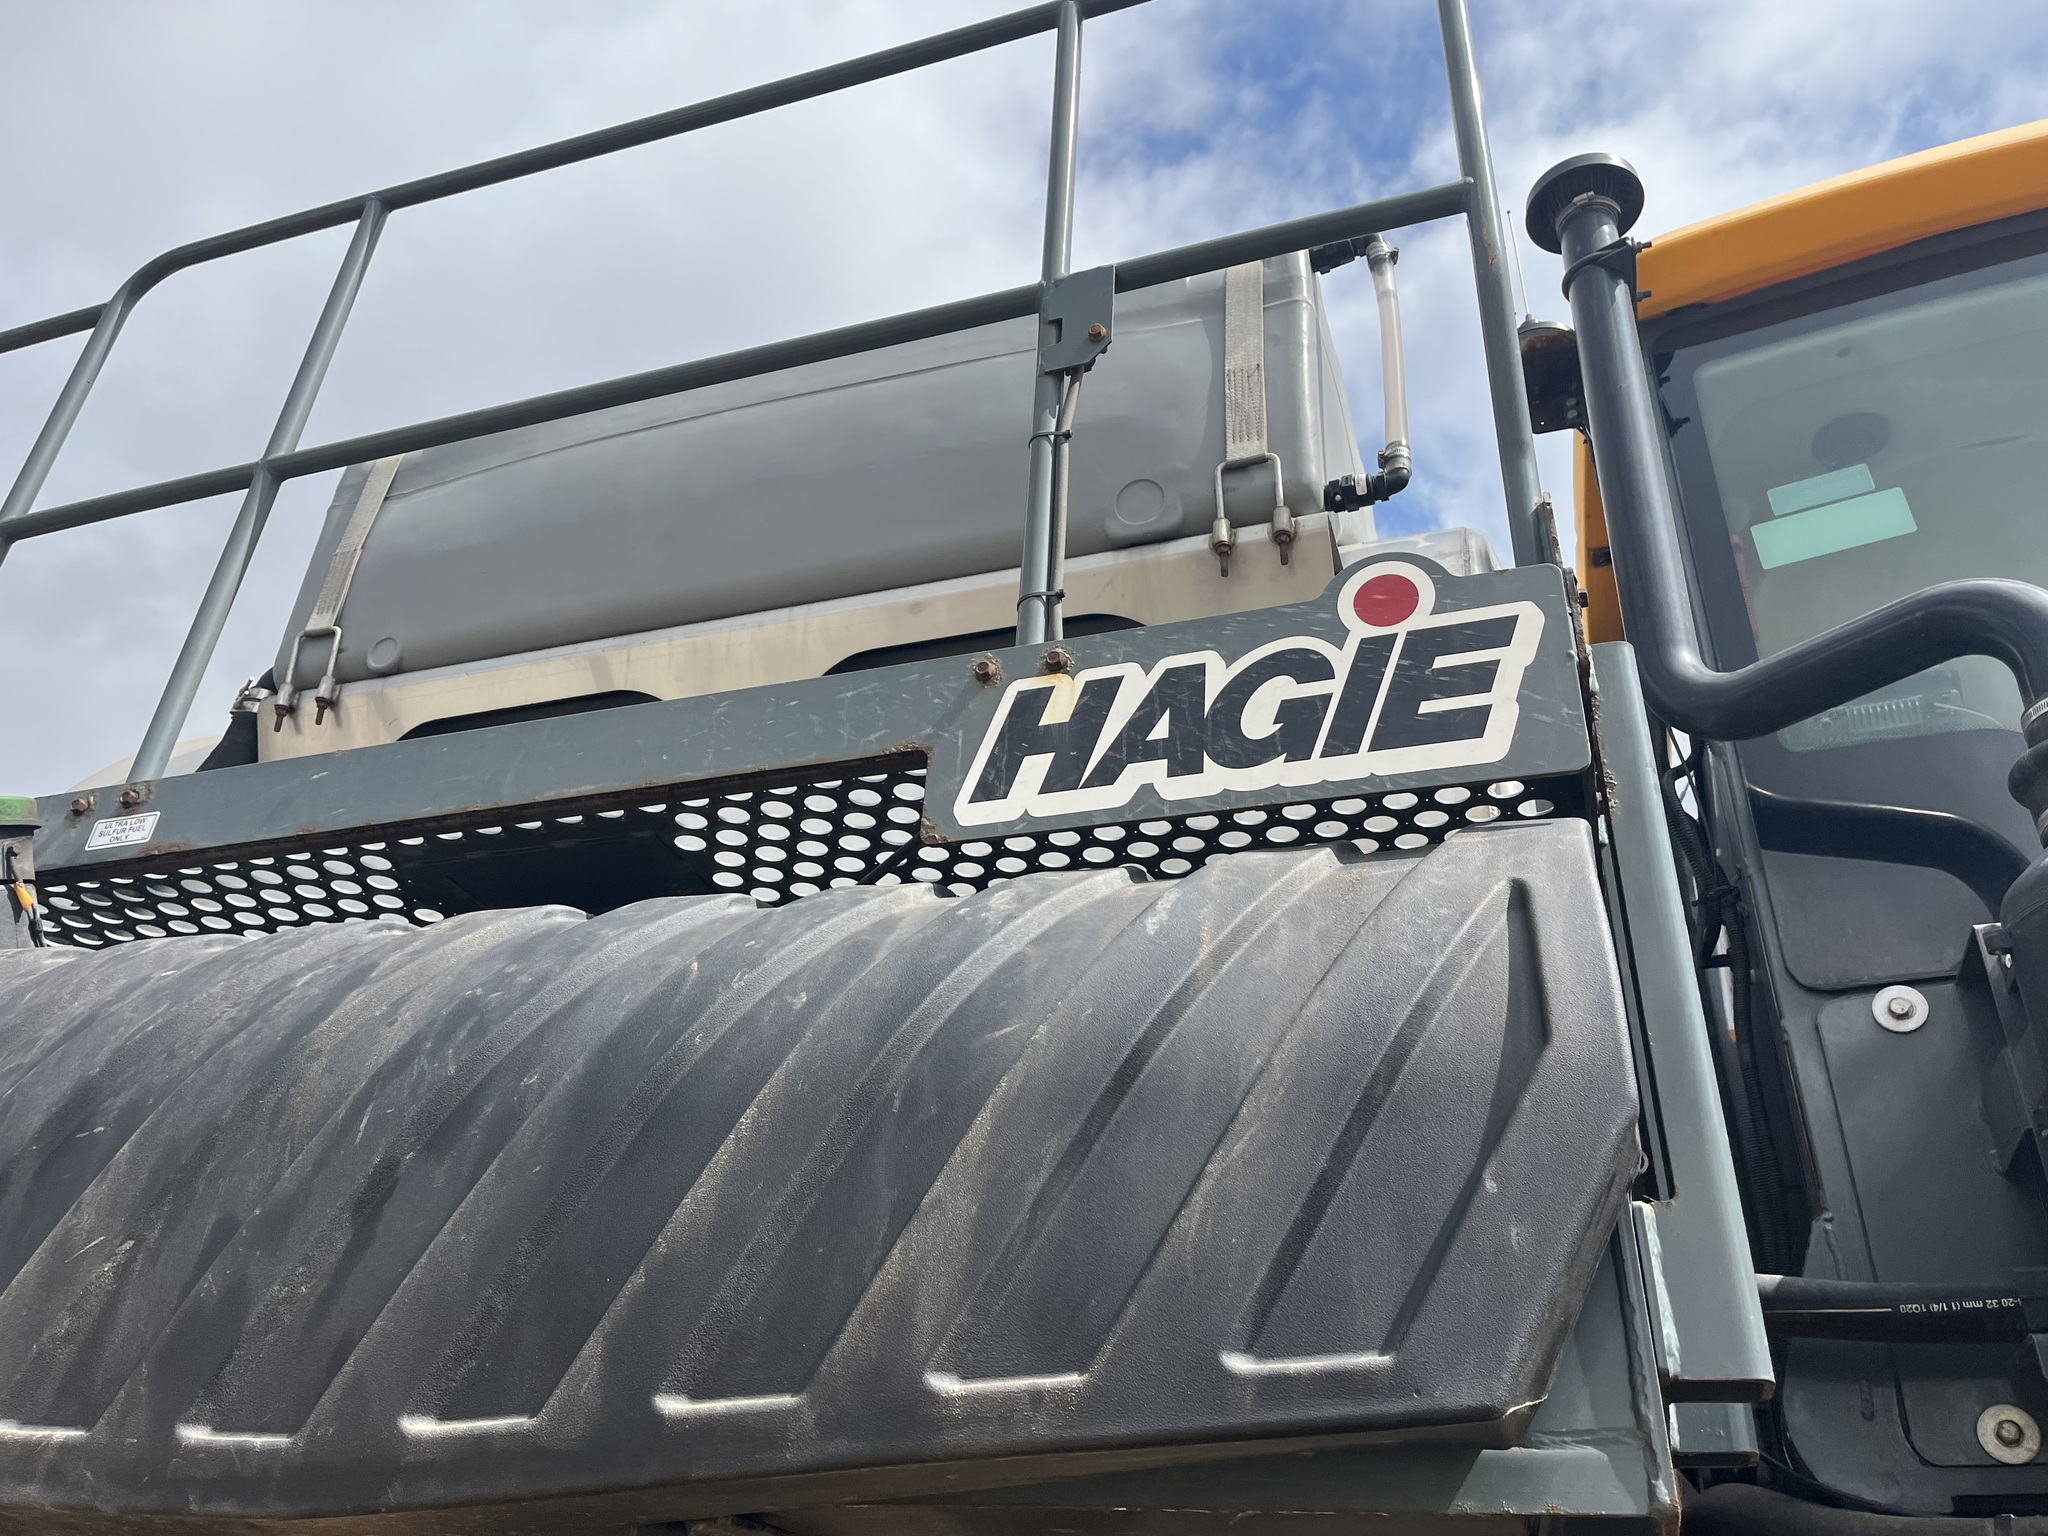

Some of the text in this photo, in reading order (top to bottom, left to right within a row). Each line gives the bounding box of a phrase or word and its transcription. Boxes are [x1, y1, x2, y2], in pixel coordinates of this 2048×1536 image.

[965, 573, 1520, 806] HAGIE
[105, 817, 148, 829] ULTRA LOW
[98, 828, 127, 837] SULFUR
[110, 834, 129, 842] ONLY
[1930, 1302, 1949, 1313] 1/4)
[1951, 1301, 1961, 1311] (1
[1962, 1300, 1984, 1308] mm
[1986, 1299, 1999, 1309] 32
